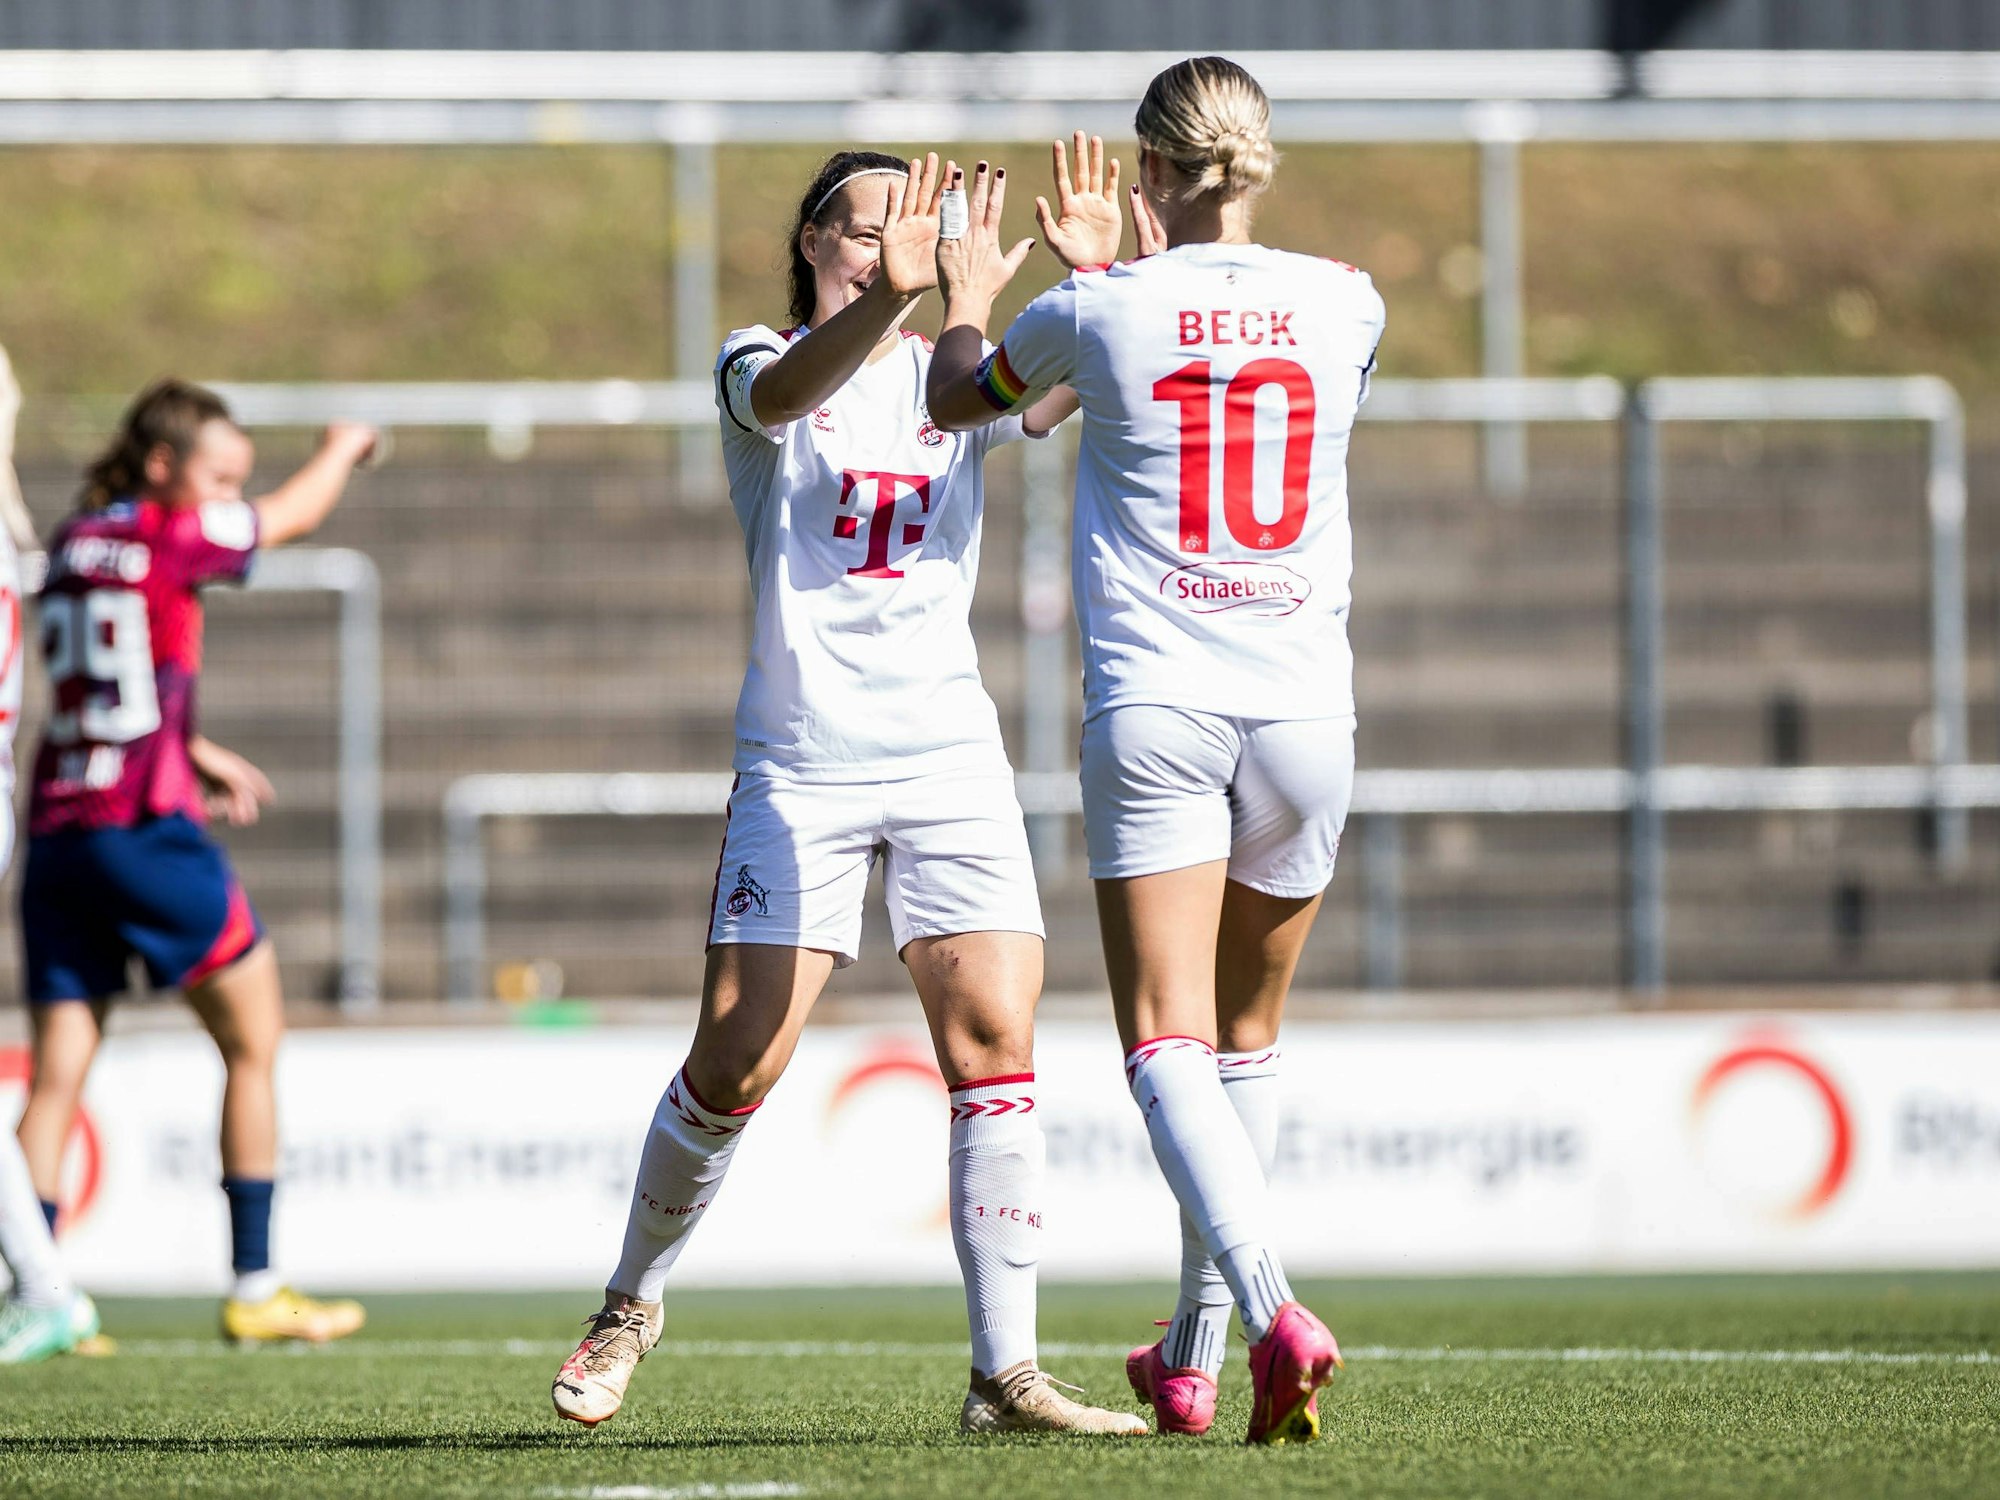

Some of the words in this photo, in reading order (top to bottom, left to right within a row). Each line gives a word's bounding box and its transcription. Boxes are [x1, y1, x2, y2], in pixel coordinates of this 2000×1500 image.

[1178, 311, 1298, 346] BECK
[1153, 358, 1316, 554] 10
[1177, 576, 1294, 599] Schaebens
[999, 1207, 1021, 1221] FC
